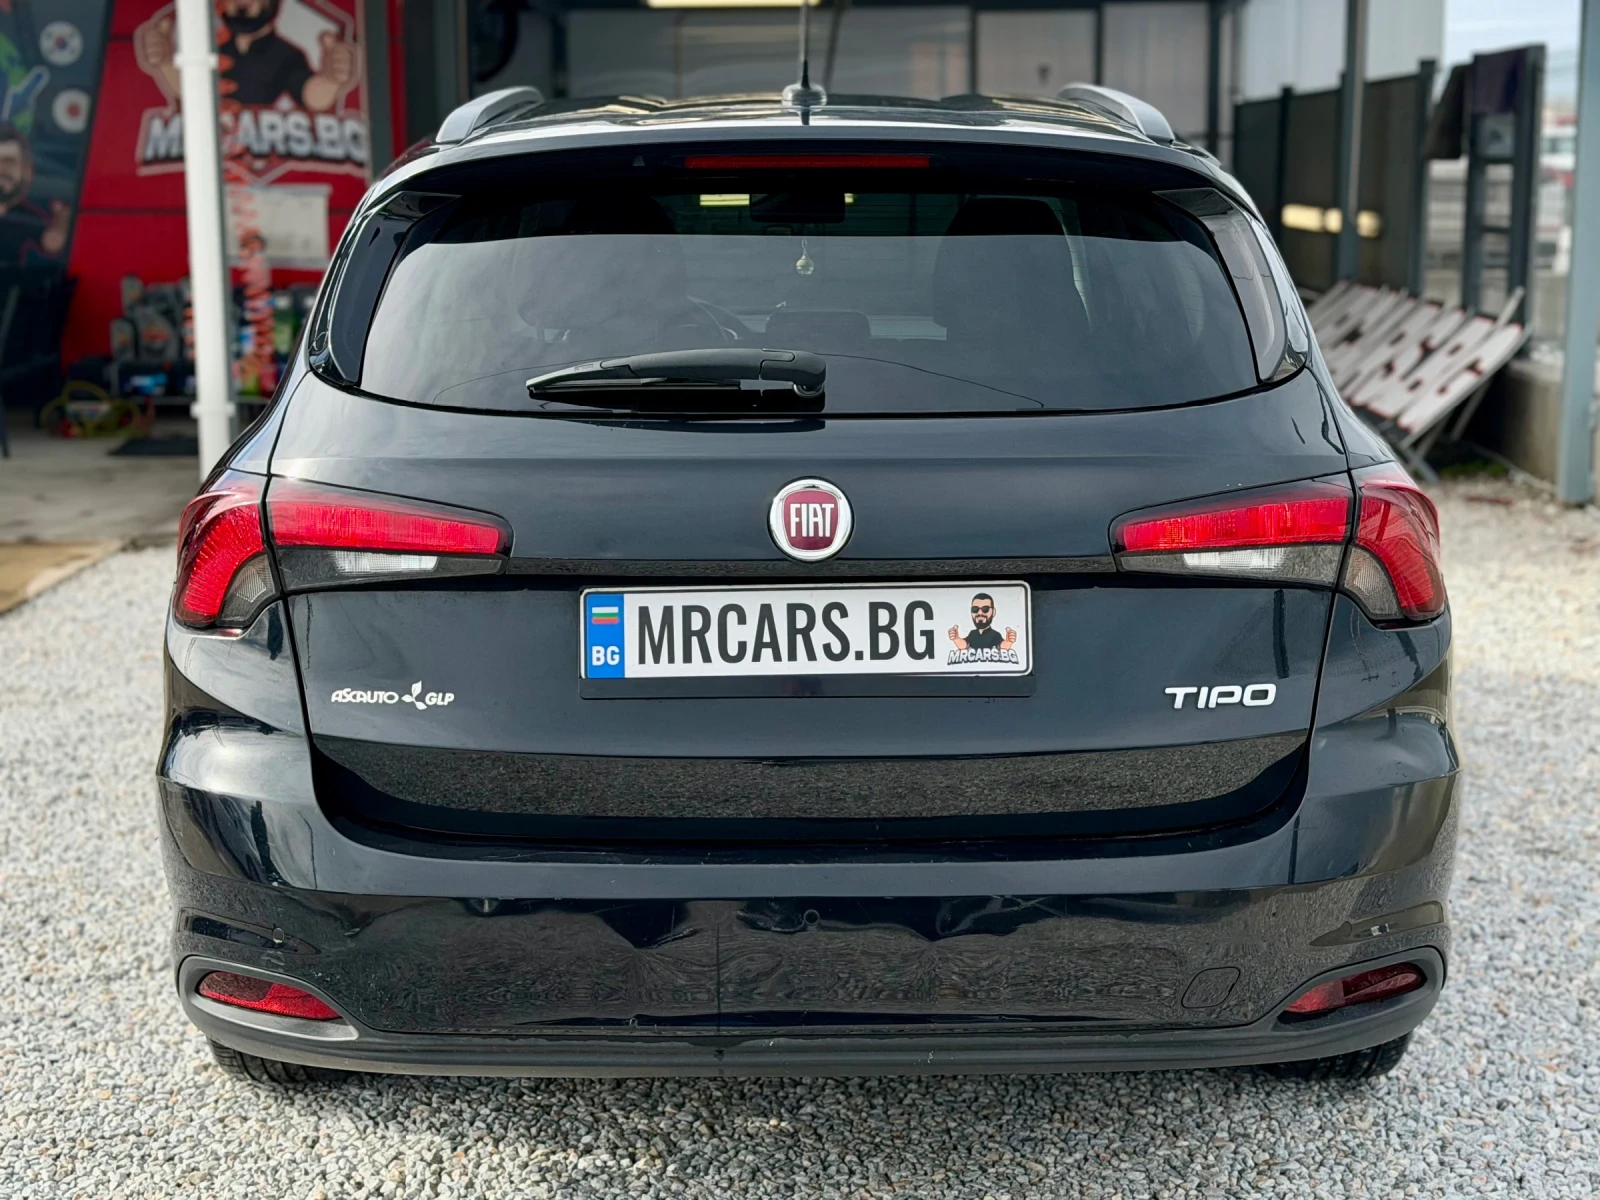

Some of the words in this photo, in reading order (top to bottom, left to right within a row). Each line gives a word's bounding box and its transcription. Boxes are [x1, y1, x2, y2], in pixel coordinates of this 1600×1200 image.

[789, 503, 835, 538] FIAT
[638, 600, 936, 665] MRCARS.BG
[591, 645, 620, 666] BG
[946, 646, 1019, 665] MRCARS.BG
[425, 692, 455, 706] GLP
[1164, 683, 1277, 709] TIPO
